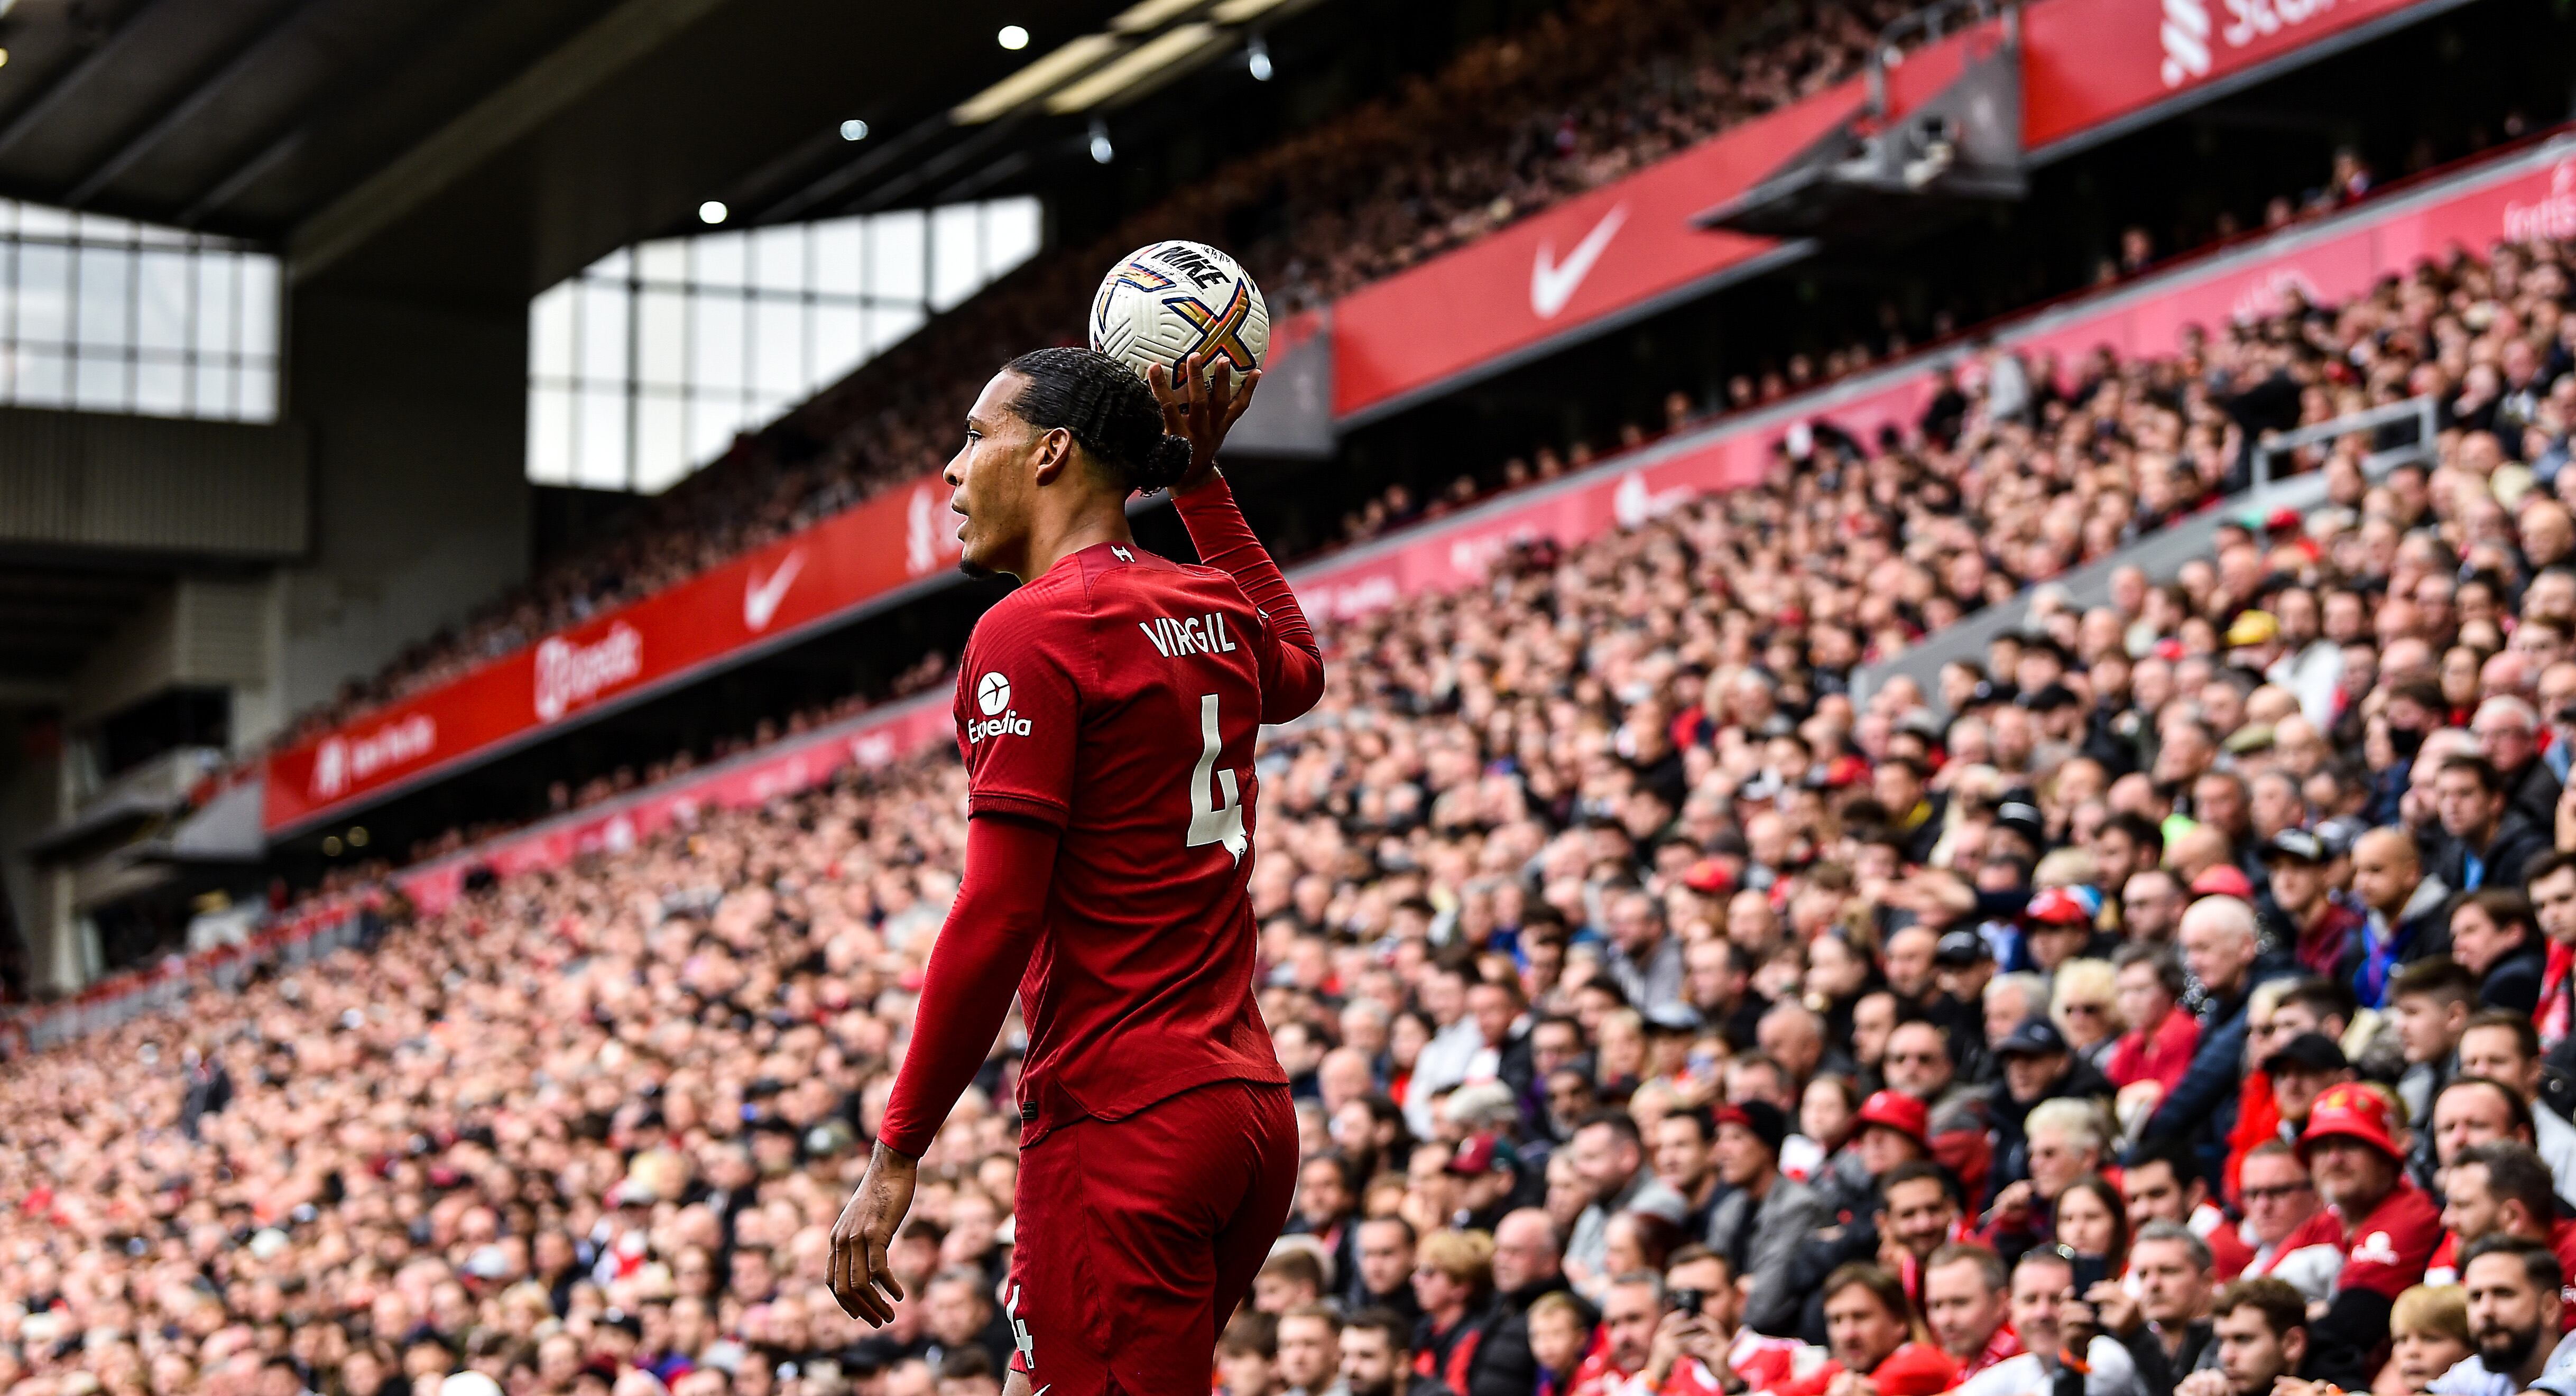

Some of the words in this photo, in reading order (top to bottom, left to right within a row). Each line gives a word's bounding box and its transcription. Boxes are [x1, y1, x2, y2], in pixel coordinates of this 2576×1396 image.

[1151, 246, 1232, 290] NIKE
[1139, 612, 1236, 657] VIRGIL
[1186, 694, 1248, 870] 4
[1006, 1284, 1035, 1369] 4
